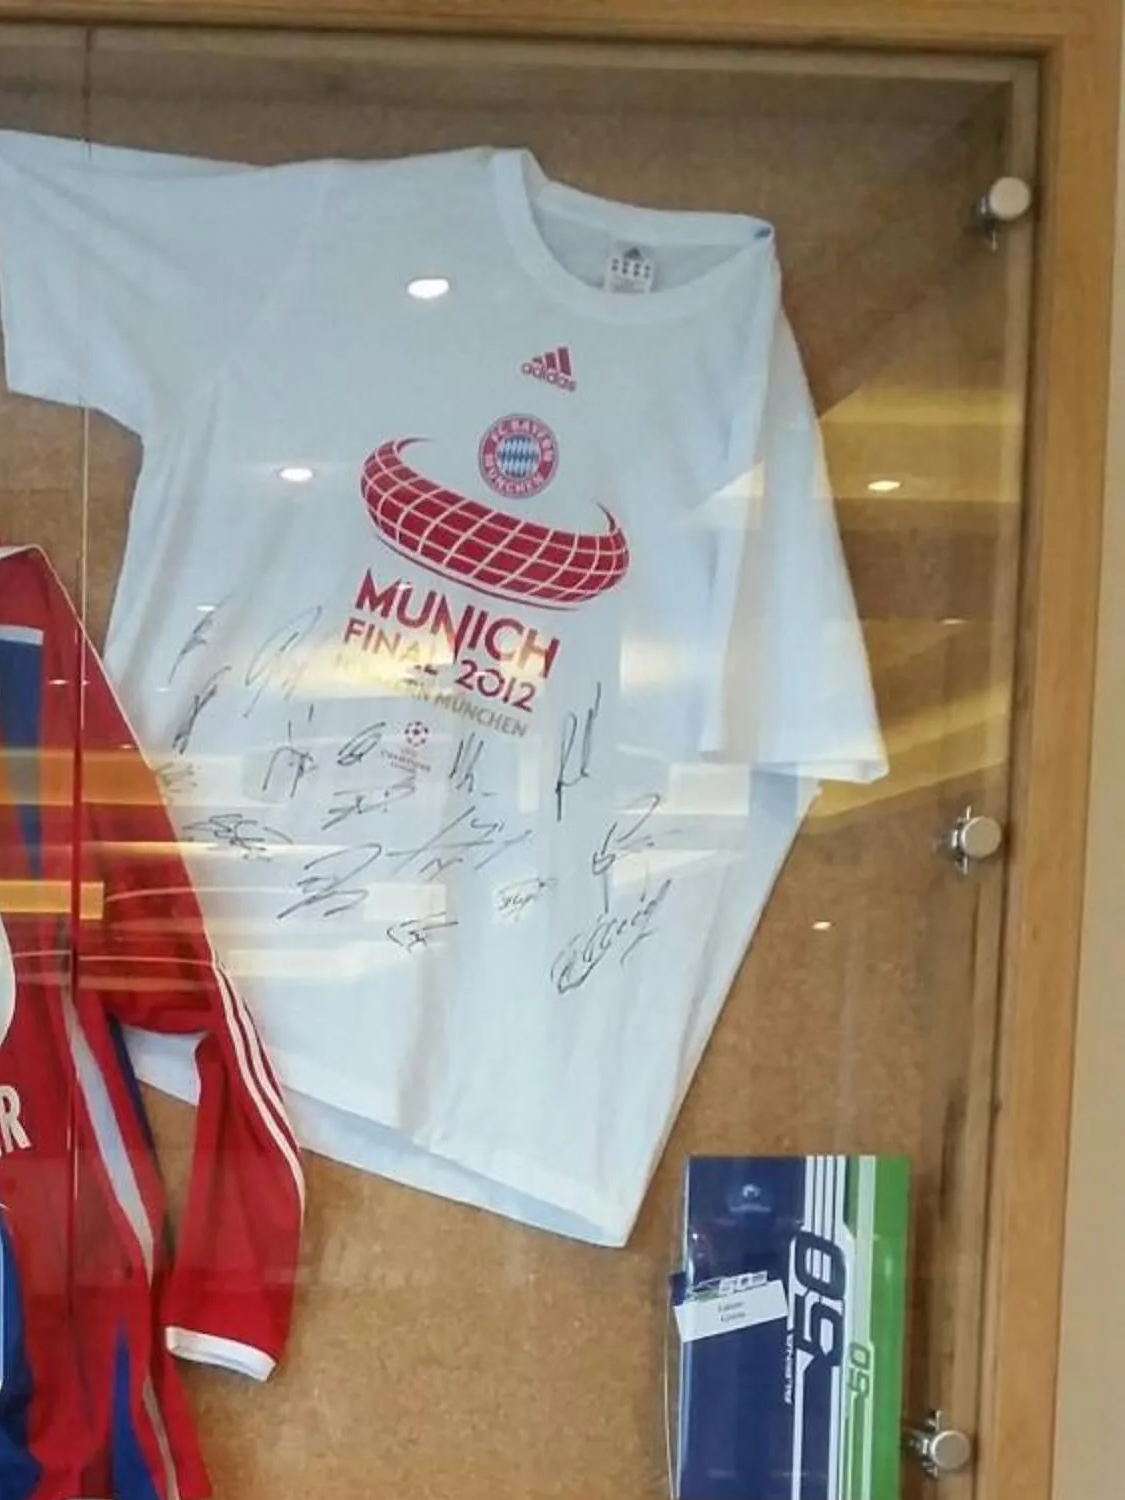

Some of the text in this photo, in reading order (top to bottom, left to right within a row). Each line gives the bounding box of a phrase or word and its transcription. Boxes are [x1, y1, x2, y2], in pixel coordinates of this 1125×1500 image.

[521, 362, 577, 393] adidas
[354, 569, 562, 680] MUNICH
[454, 658, 536, 714] 2012
